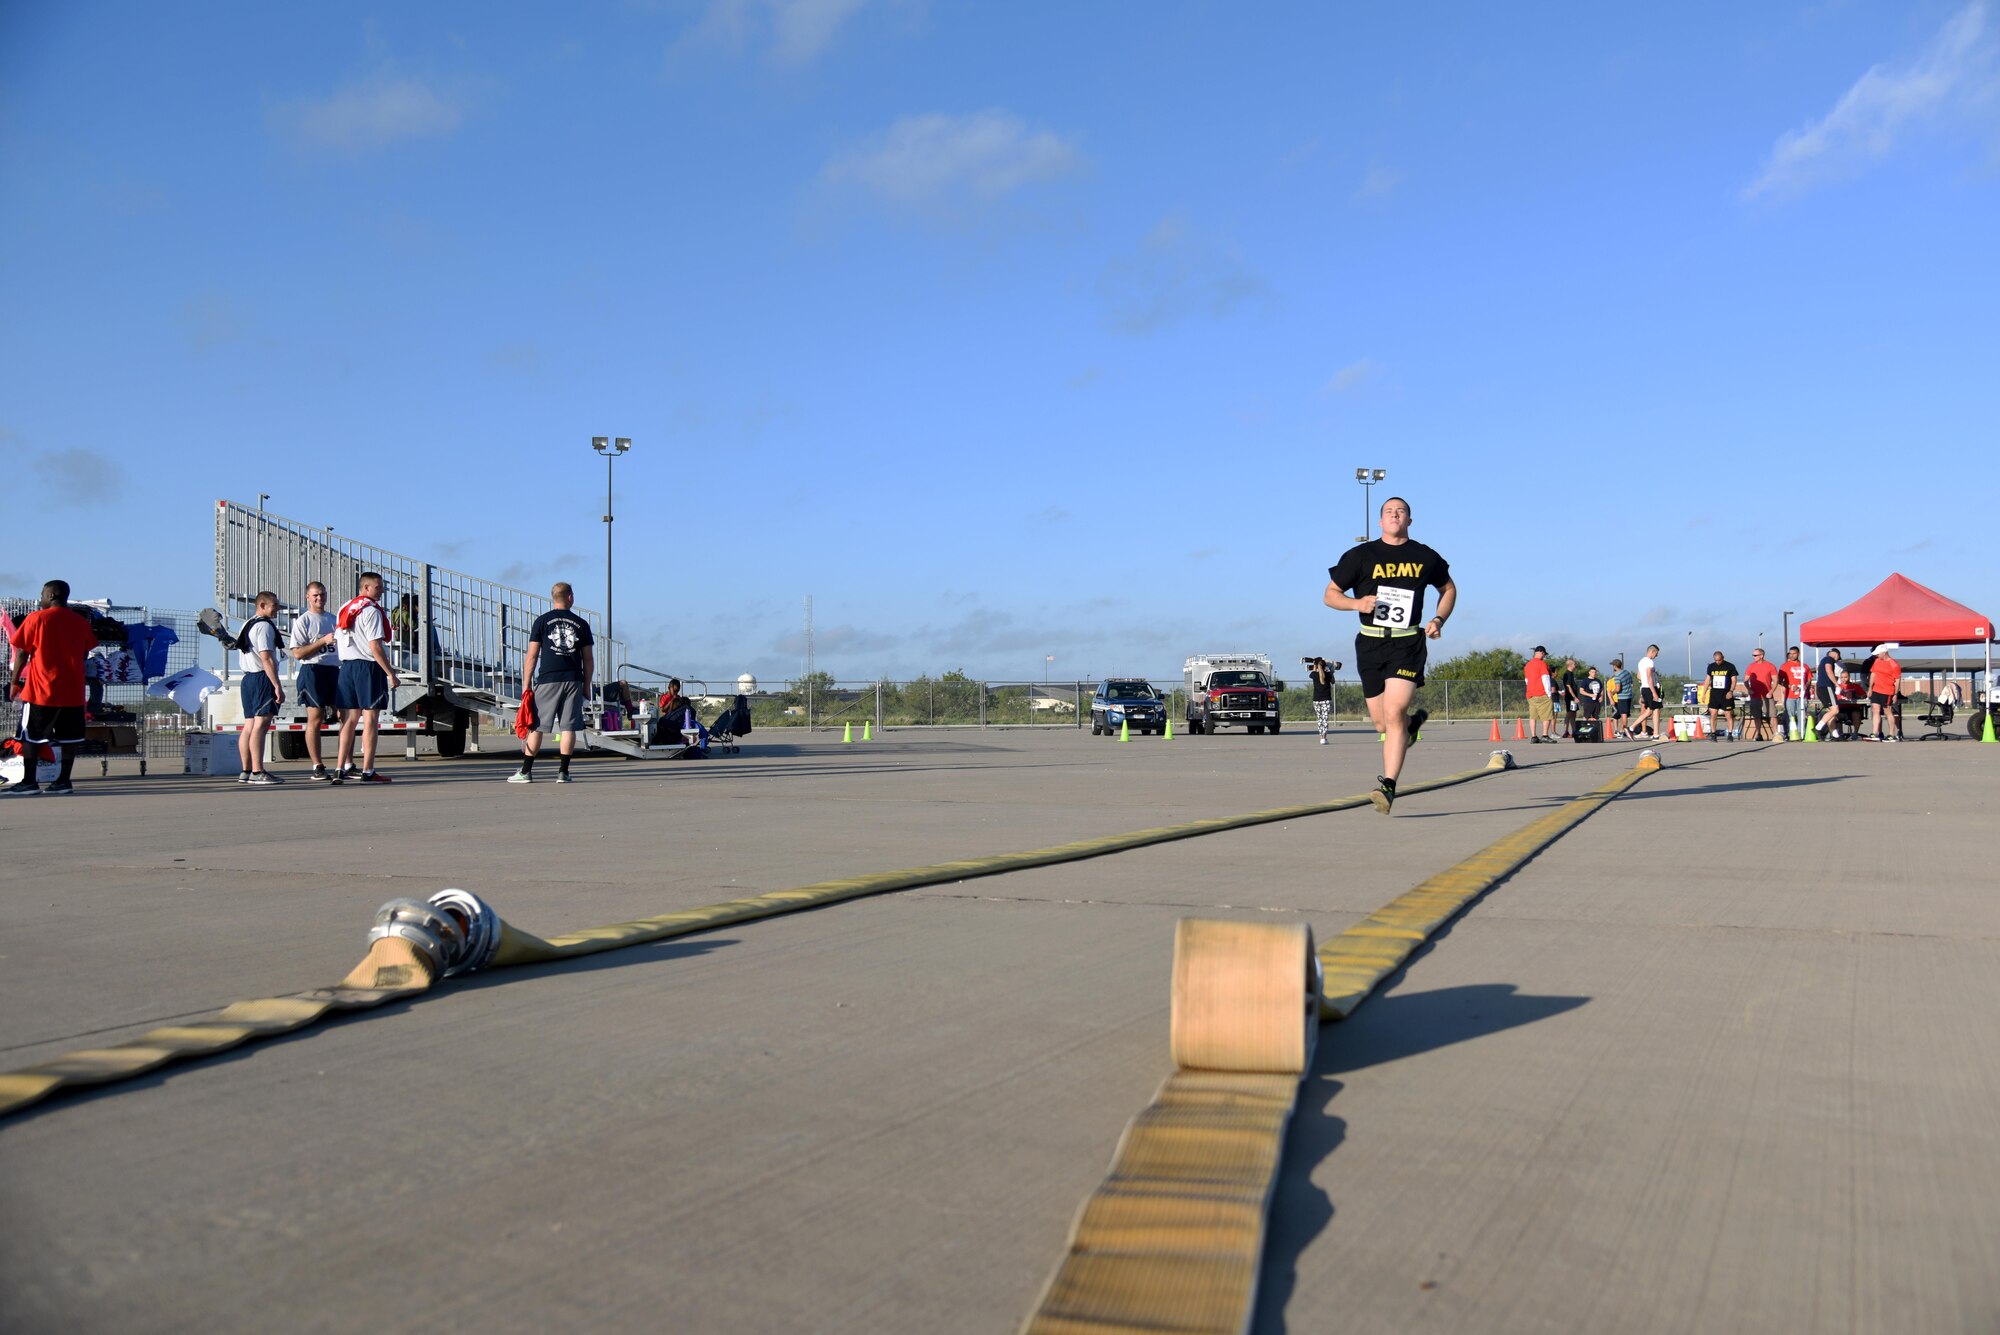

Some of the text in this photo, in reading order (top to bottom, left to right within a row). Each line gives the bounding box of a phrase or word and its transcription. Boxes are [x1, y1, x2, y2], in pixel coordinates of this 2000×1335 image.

[1372, 563, 1423, 579] ARMY
[1376, 605, 1404, 623] 33
[1397, 669, 1416, 678] ARMY
